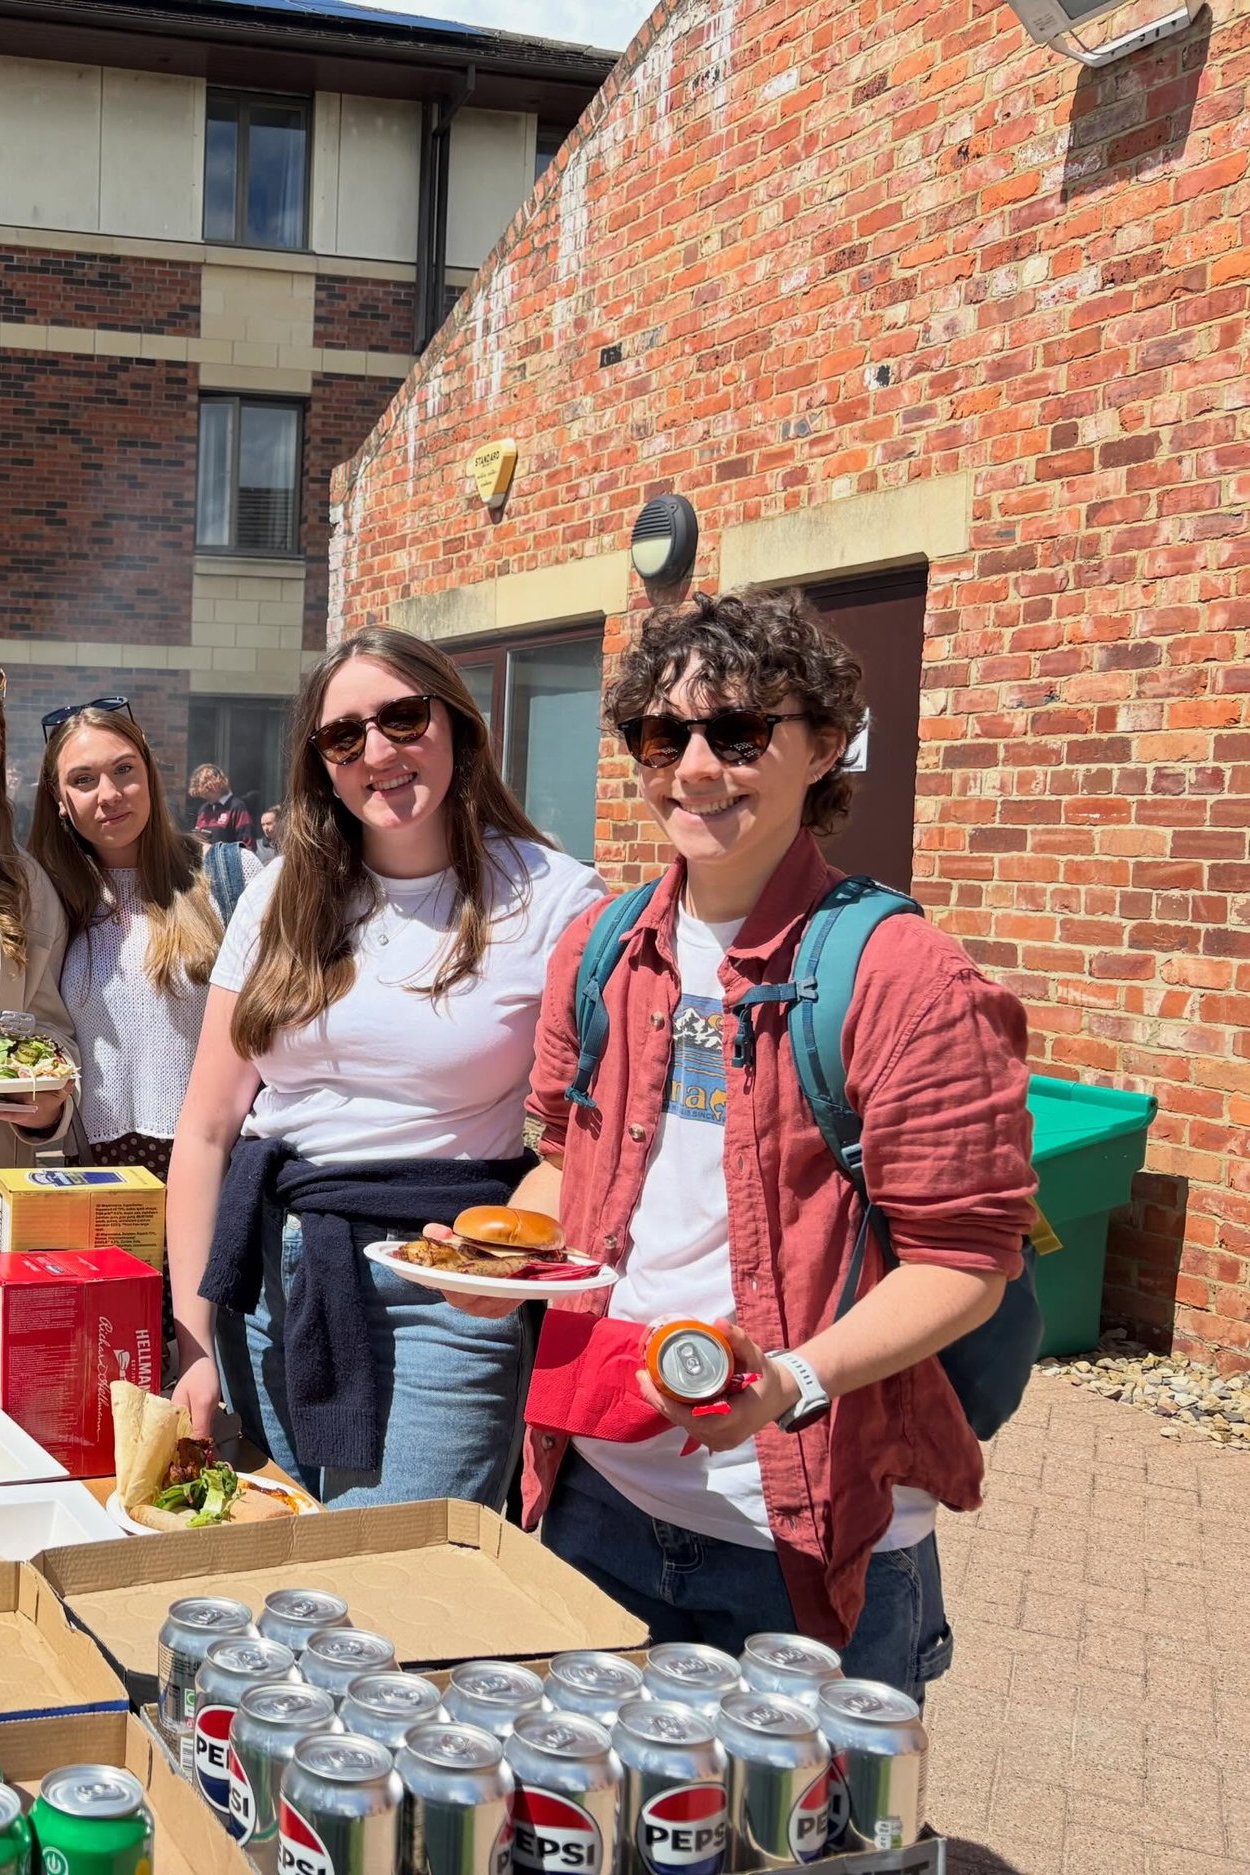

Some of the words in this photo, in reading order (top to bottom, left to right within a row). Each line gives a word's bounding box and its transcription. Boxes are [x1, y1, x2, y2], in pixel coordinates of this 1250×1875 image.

[135, 1329, 153, 1393] HELLMAN
[516, 1826, 596, 1867] EPSI
[645, 1822, 726, 1853] PEPS
